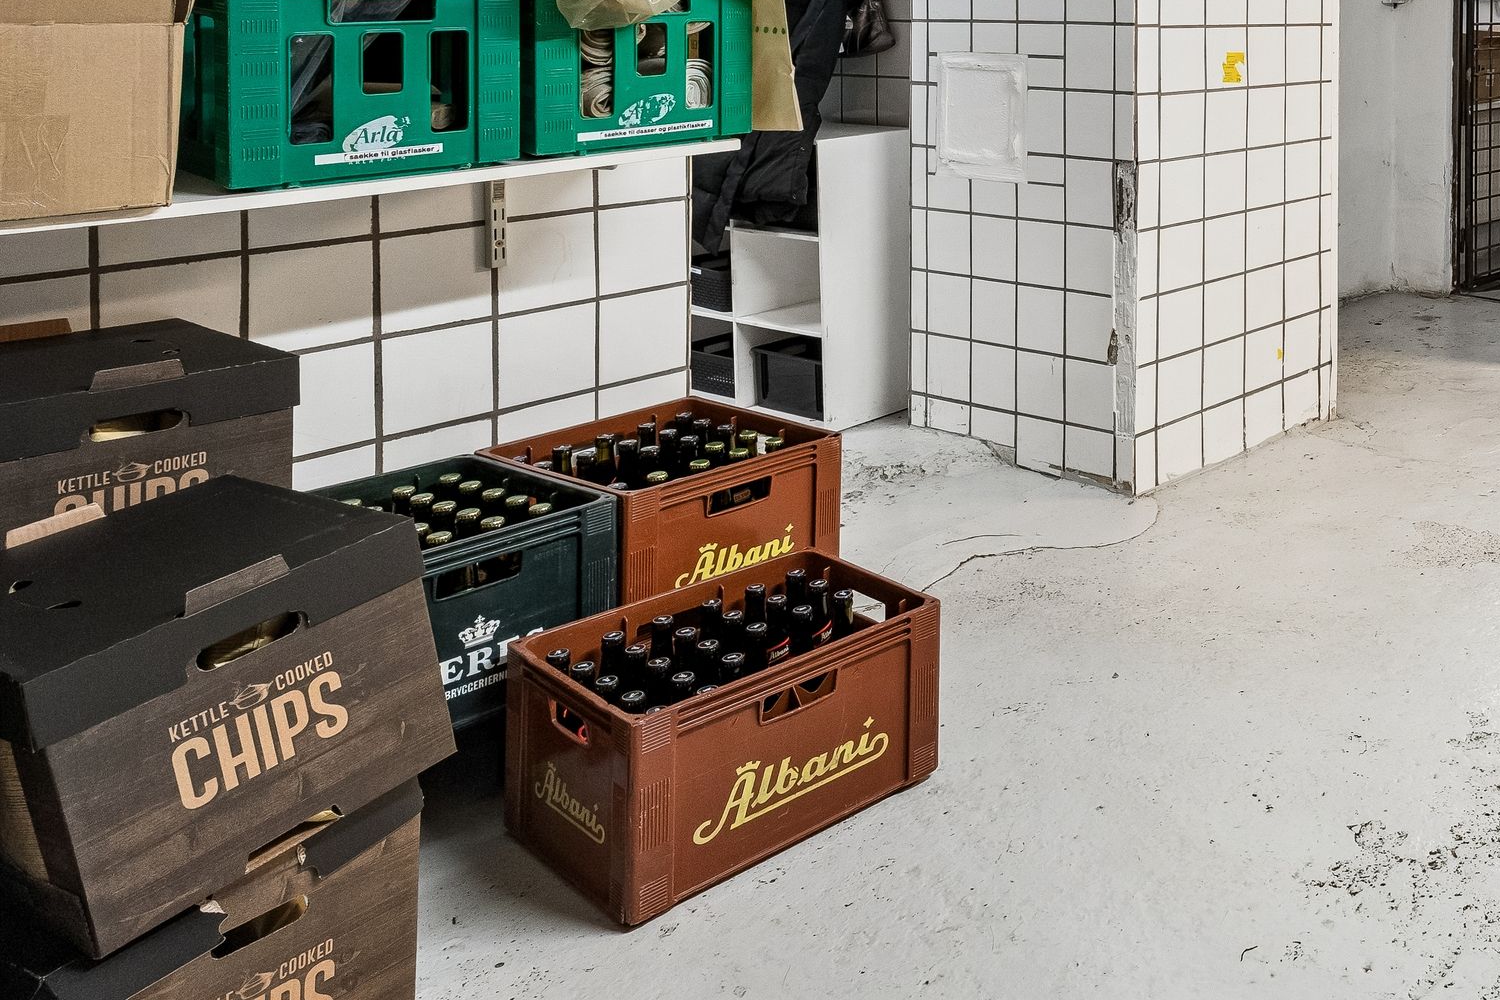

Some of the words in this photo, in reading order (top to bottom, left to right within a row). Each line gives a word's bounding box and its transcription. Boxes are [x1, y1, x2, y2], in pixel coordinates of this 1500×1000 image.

[355, 125, 399, 145] Arla
[391, 146, 435, 157] glasflasker
[57, 470, 111, 495] KETTLE
[154, 451, 207, 475] COOKED
[275, 651, 333, 691] COOKED
[168, 701, 230, 743] KETTLE
[171, 670, 349, 810] CHIPS
[693, 716, 890, 845] Albani
[534, 760, 606, 845] Albani
[279, 938, 333, 980] COOKED
